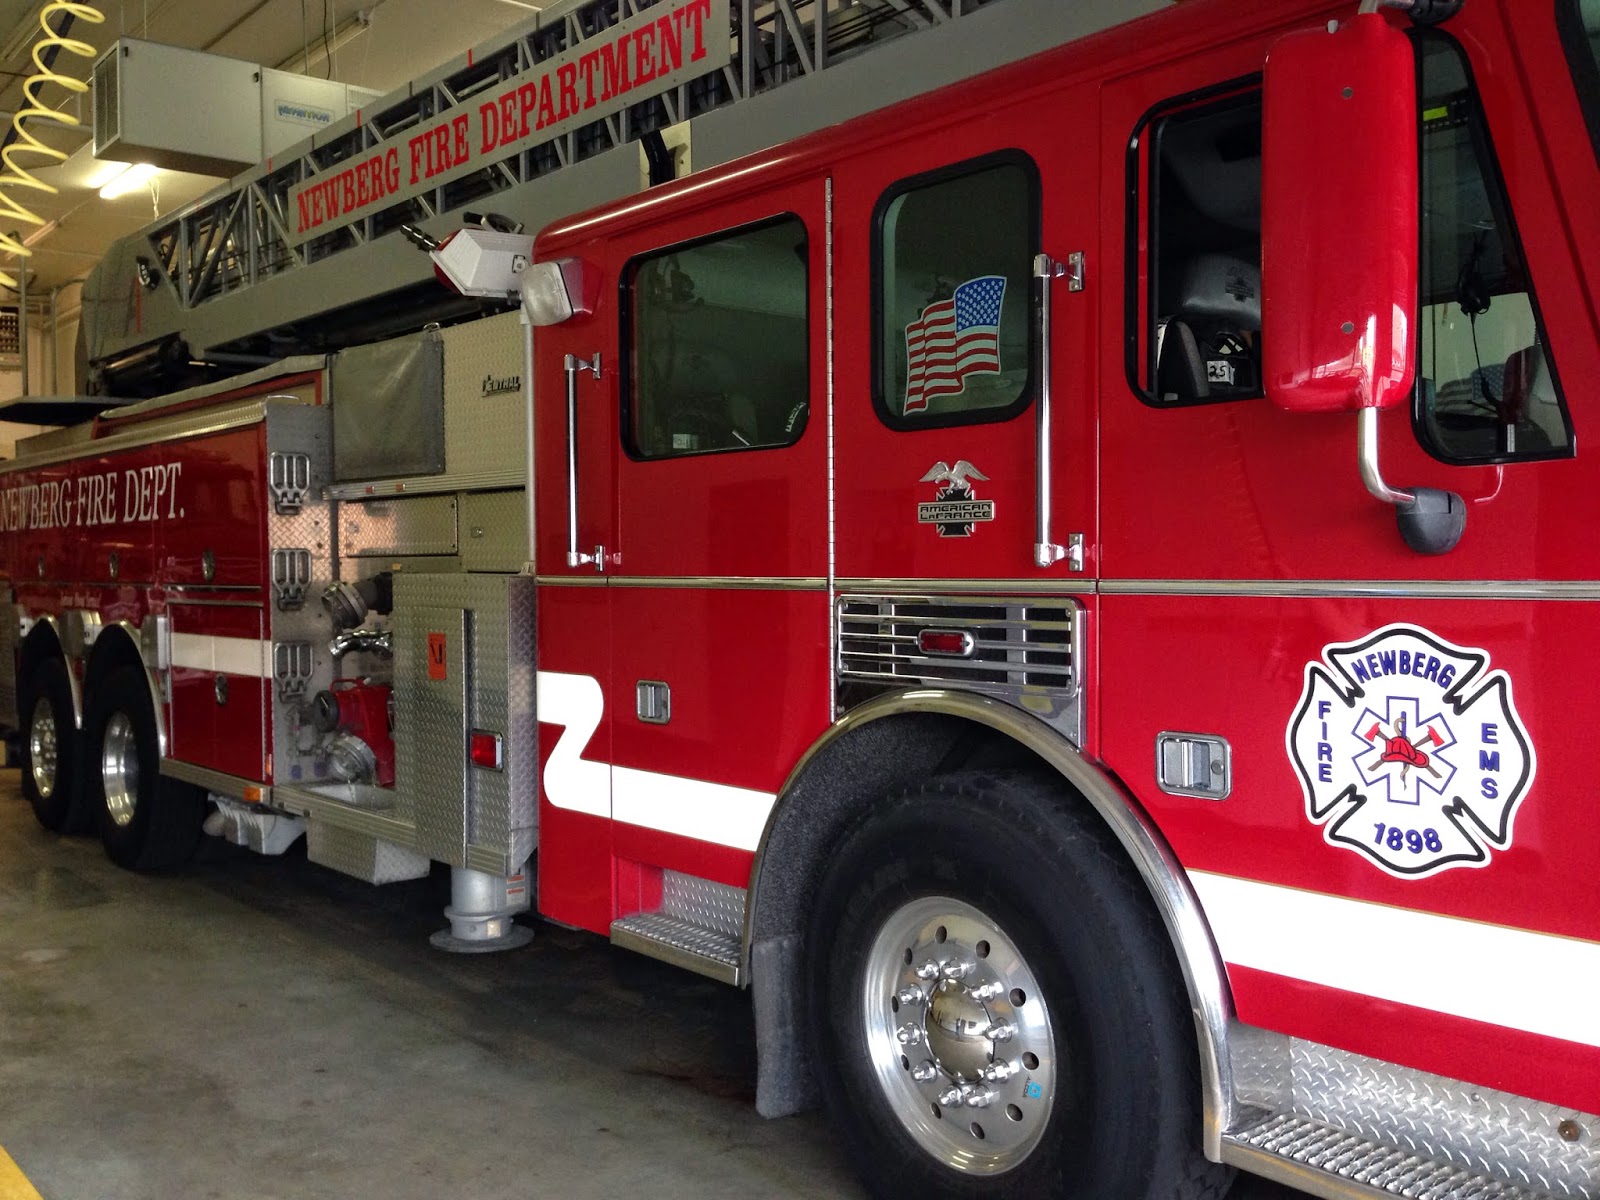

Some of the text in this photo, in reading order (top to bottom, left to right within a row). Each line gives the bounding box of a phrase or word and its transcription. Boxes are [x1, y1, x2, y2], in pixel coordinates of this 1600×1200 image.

[297, 0, 711, 233] NEWBERG FIRE DEPARTMENT
[0, 462, 185, 531] NEWBERG FIRE DEPT.
[920, 503, 991, 513] AMERICAN
[1351, 649, 1456, 689] NEWBERG
[1317, 700, 1333, 783] FIRE
[1478, 722, 1501, 800] EMS
[1373, 822, 1443, 854] 1898
